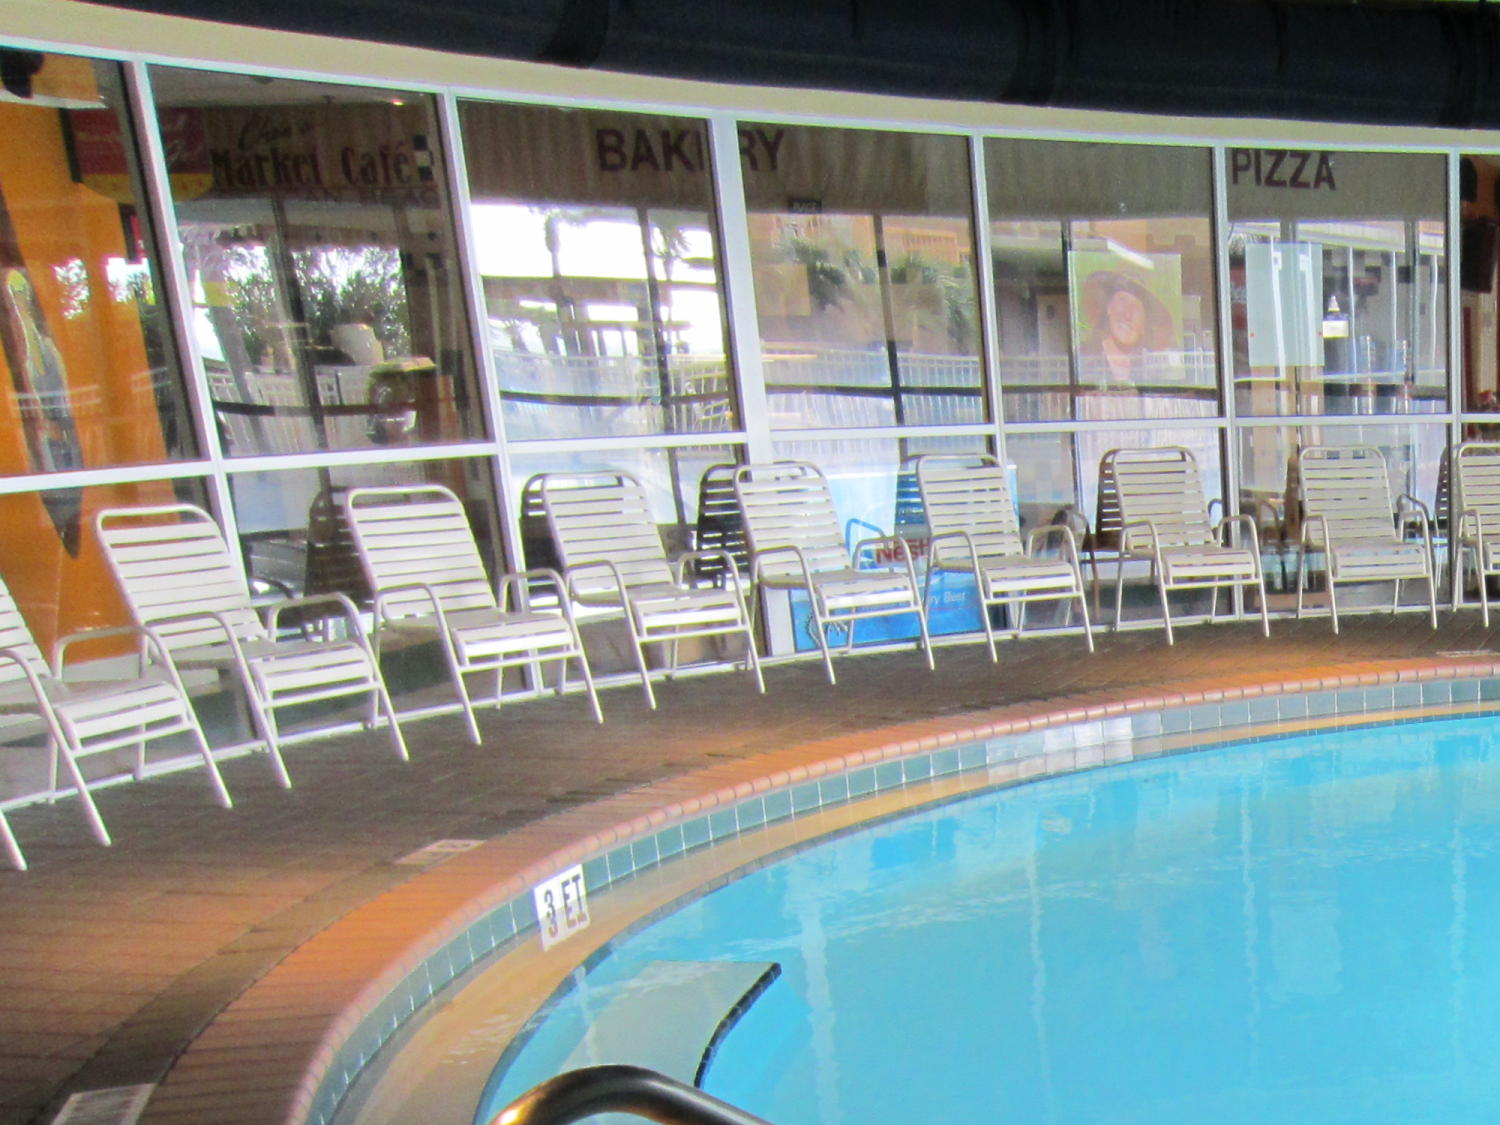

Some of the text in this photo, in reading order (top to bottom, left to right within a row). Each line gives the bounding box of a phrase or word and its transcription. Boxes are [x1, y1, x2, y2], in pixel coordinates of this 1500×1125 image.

[210, 140, 412, 188] Market Café
[596, 128, 783, 172] BAKRY
[1231, 150, 1336, 190] PIZZA
